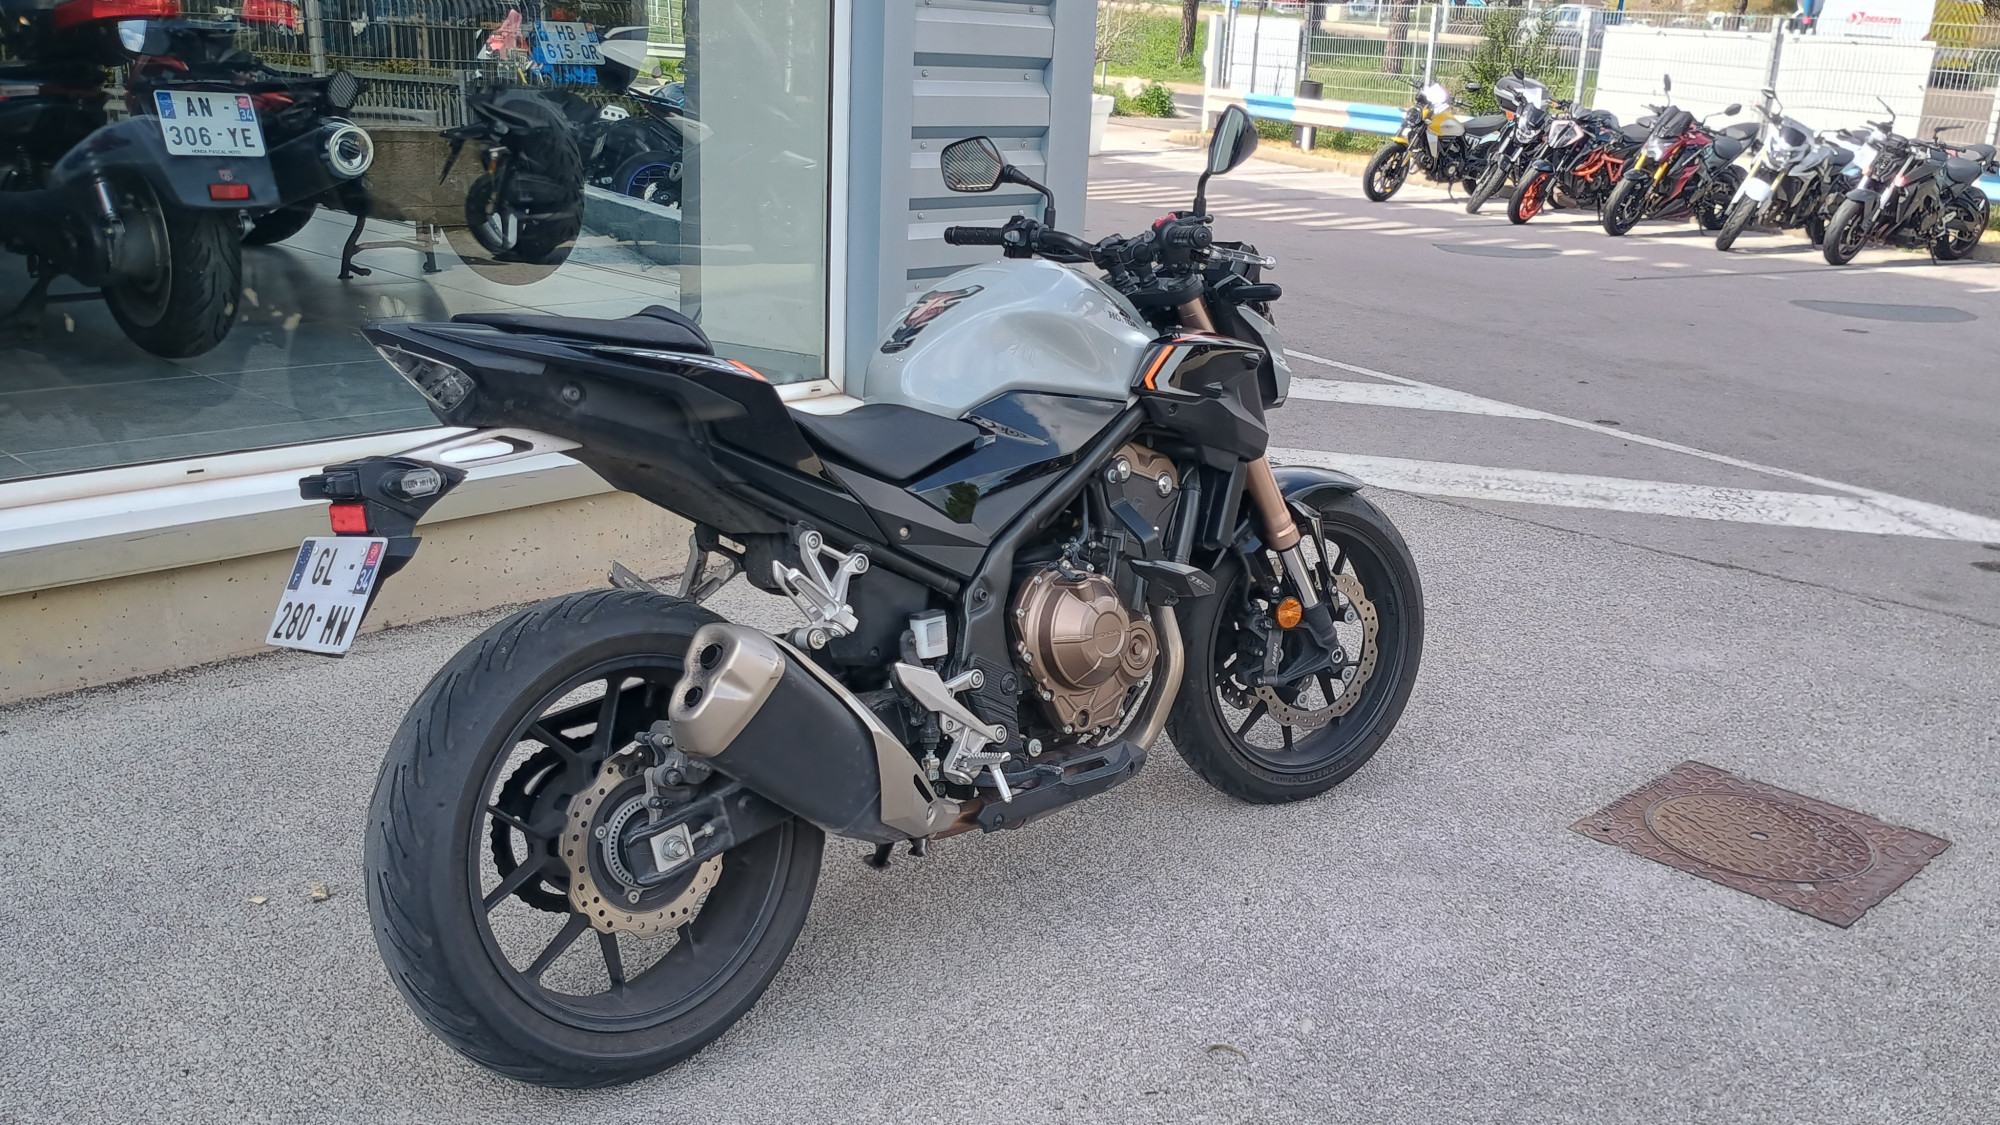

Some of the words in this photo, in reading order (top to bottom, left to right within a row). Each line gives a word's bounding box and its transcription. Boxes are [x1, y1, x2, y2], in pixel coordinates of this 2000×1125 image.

[555, 25, 577, 41] HB
[186, 96, 213, 117] AN
[240, 109, 253, 120] 34
[312, 548, 338, 586] GL
[292, 573, 301, 585] F
[355, 568, 371, 591] 34
[1299, 758, 1347, 782] MICHELIN
